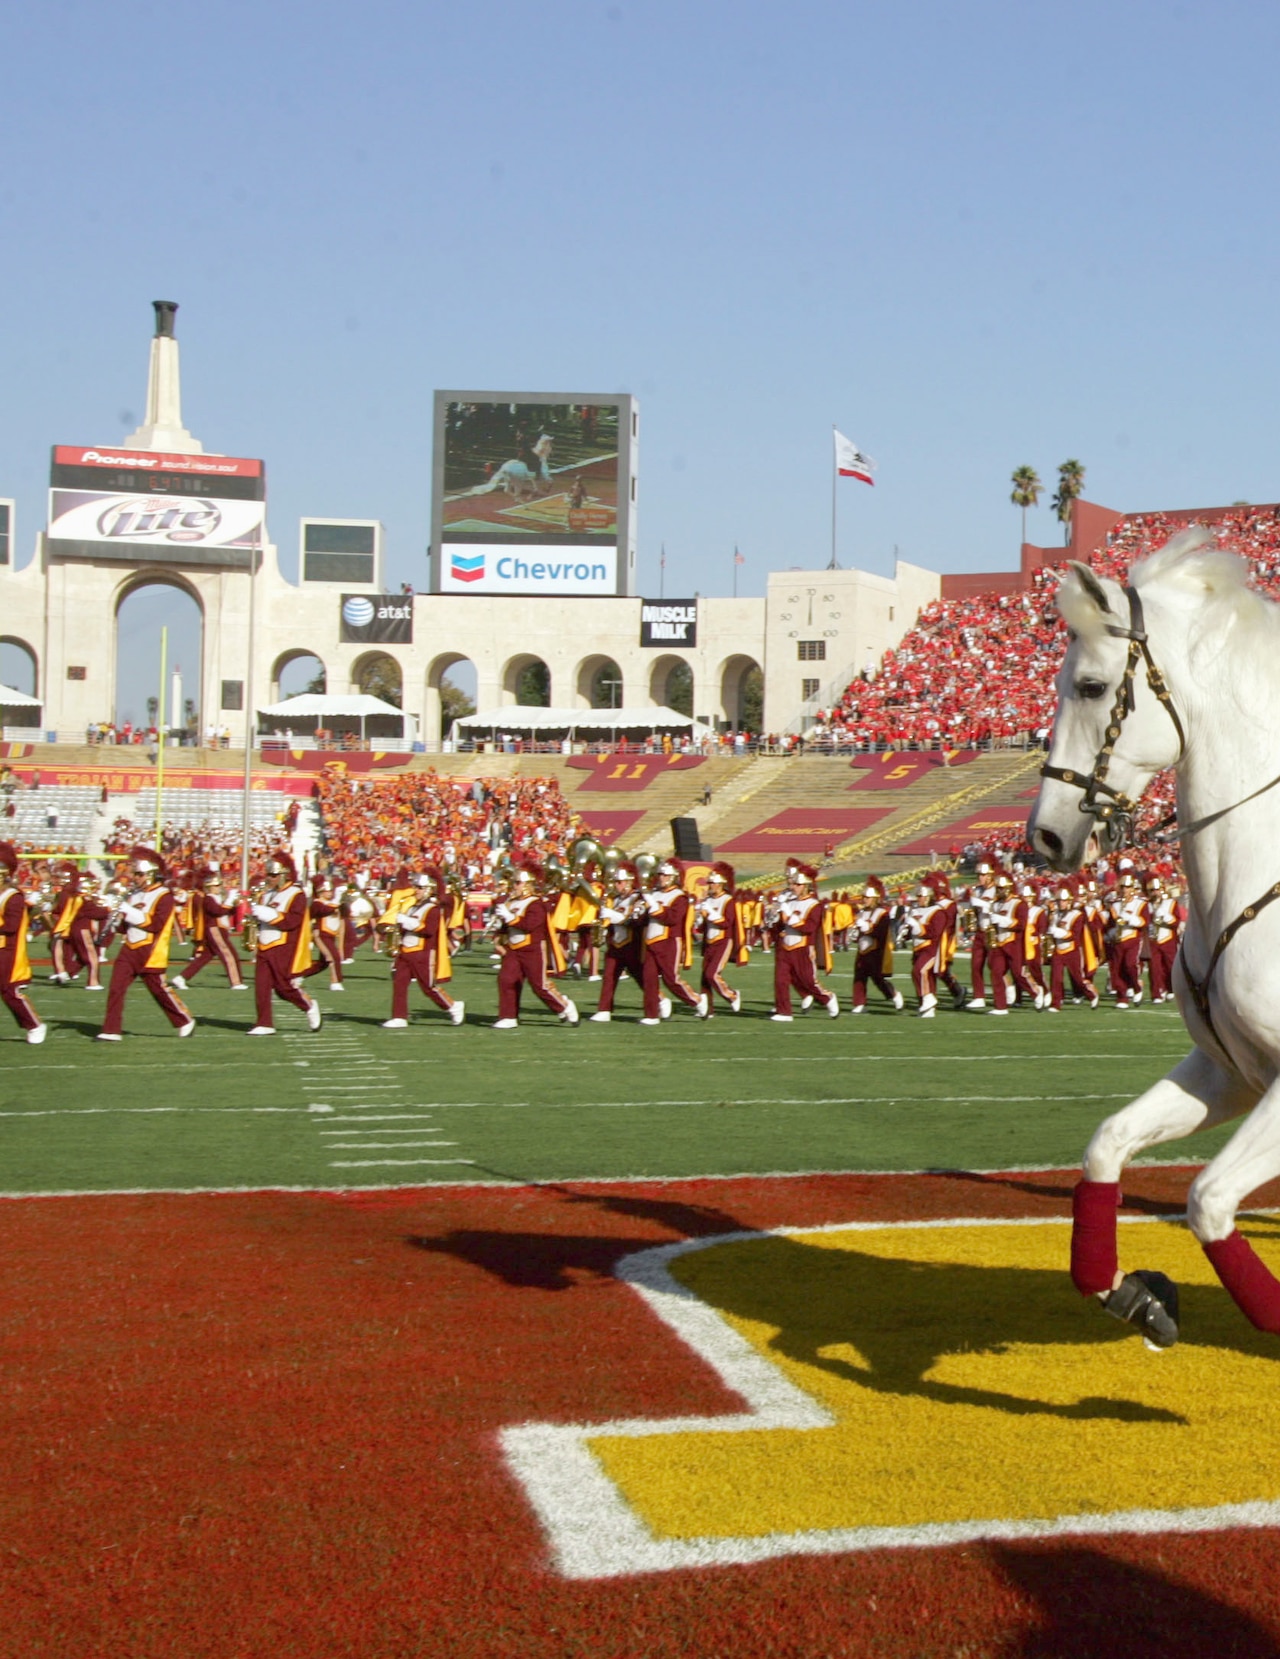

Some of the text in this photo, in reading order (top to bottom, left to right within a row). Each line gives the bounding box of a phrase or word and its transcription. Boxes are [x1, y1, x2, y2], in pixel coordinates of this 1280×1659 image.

[81, 451, 158, 467] Pioneer
[103, 508, 218, 537] Lite
[496, 557, 606, 580] Chevron
[787, 595, 799, 603] 60
[823, 594, 835, 602] 80
[378, 605, 411, 619] at&t
[642, 605, 696, 622] MUSCLE
[780, 613, 792, 621] 50
[829, 611, 841, 620] 90
[651, 622, 689, 639] MILK
[823, 629, 838, 637] 100
[606, 764, 648, 779] 11
[884, 765, 917, 779] 5
[56, 773, 193, 791] TROJAN NATON
